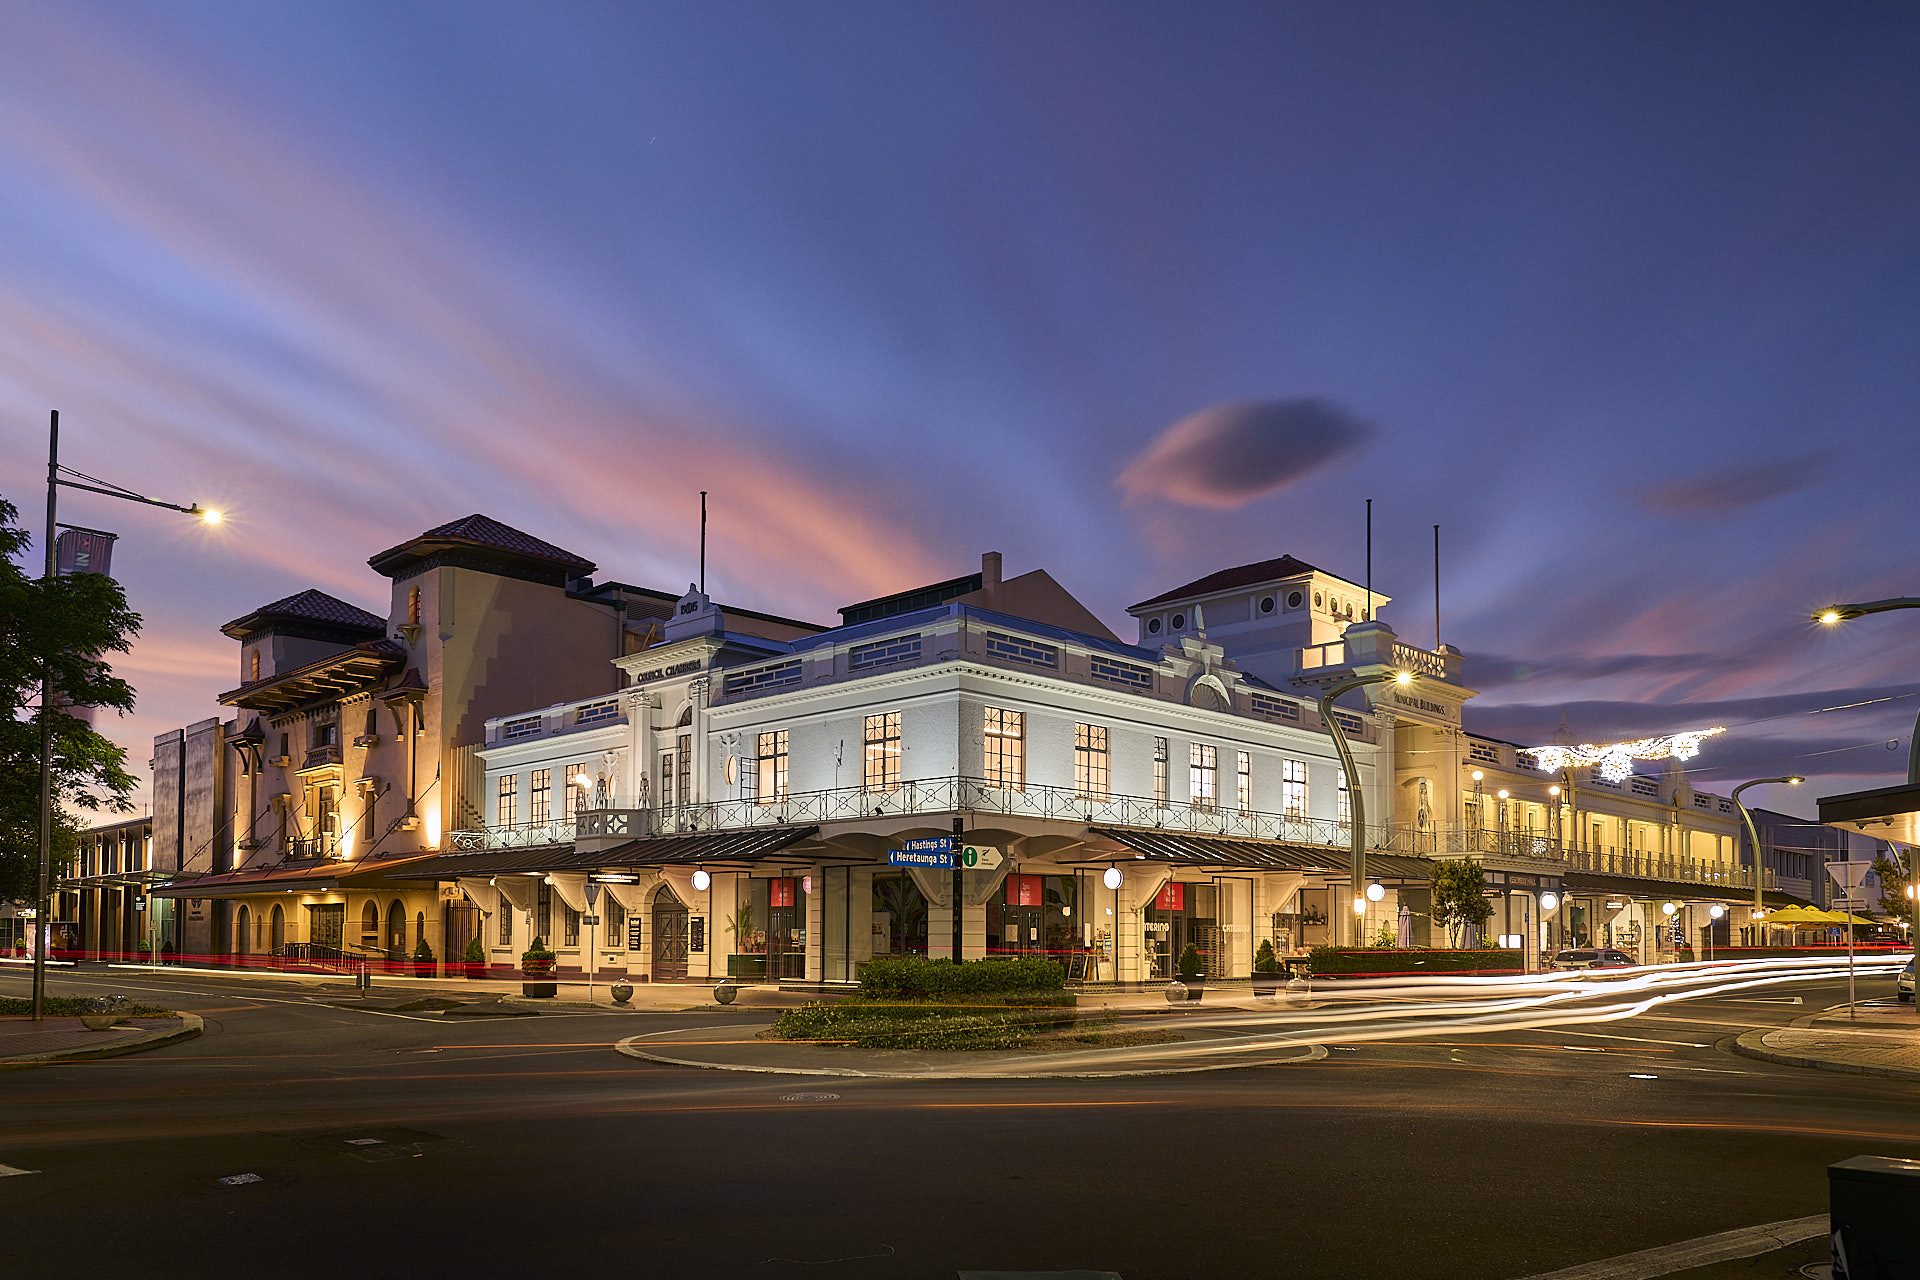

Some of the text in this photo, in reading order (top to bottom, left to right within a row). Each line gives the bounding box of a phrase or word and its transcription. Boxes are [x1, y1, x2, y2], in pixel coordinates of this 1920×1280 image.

[638, 668, 664, 682] COUNCIL
[1394, 692, 1419, 709] MUNICIPAL
[911, 839, 947, 851] Hastings St
[896, 852, 948, 866] Heretaunga St
